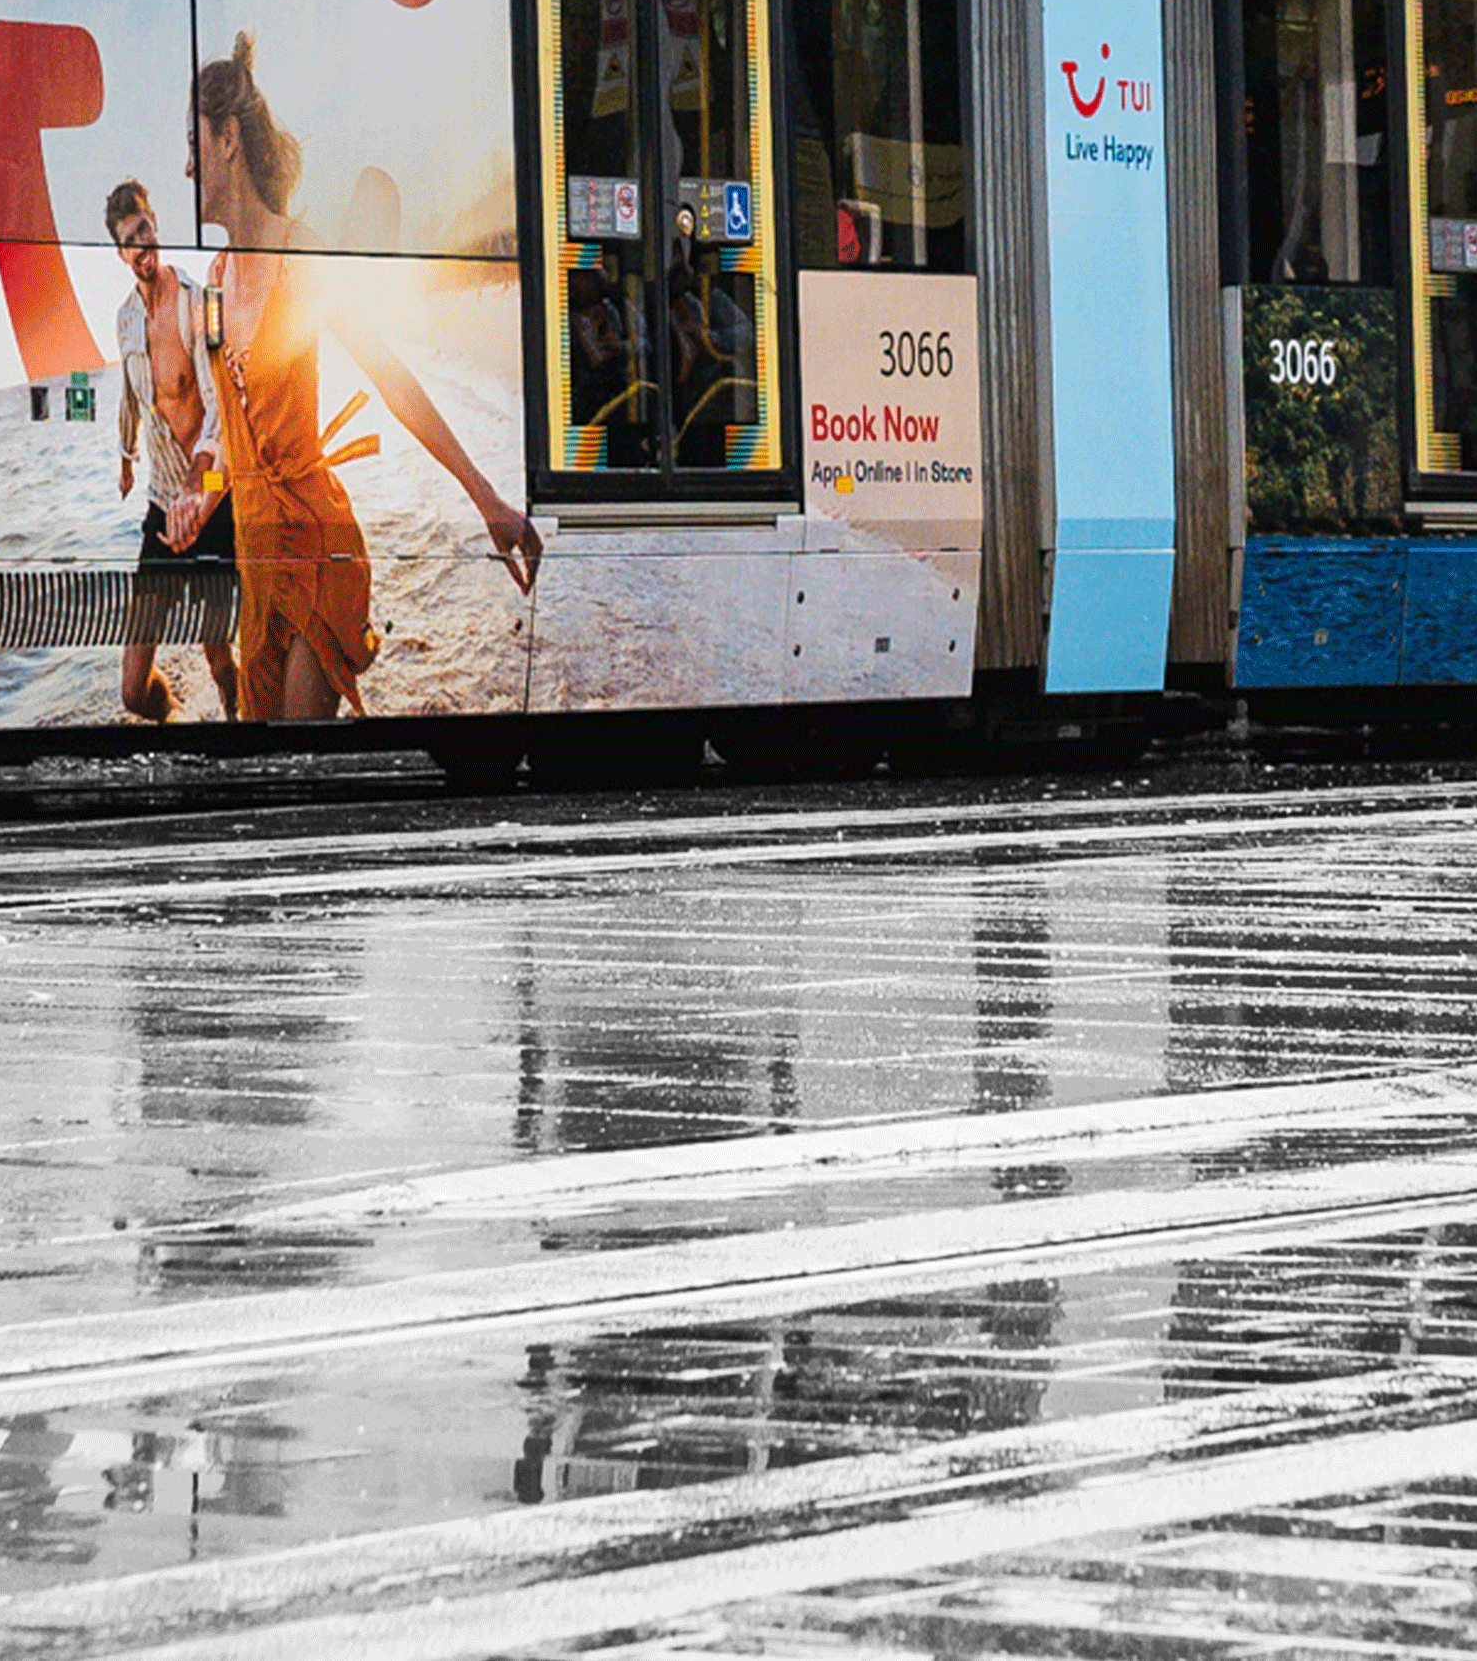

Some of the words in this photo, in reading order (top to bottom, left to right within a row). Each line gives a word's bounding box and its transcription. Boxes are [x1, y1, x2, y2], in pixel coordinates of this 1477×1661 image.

[1116, 79, 1152, 112] TUI
[1066, 131, 1099, 161] Live
[1103, 133, 1155, 171] Happy
[879, 330, 954, 378] 3066
[1268, 338, 1337, 386] 3066
[810, 403, 878, 443] Book
[883, 404, 940, 443] Now
[810, 460, 843, 489] App
[854, 459, 903, 483] Online
[914, 459, 928, 483] In
[930, 459, 973, 484] Store
